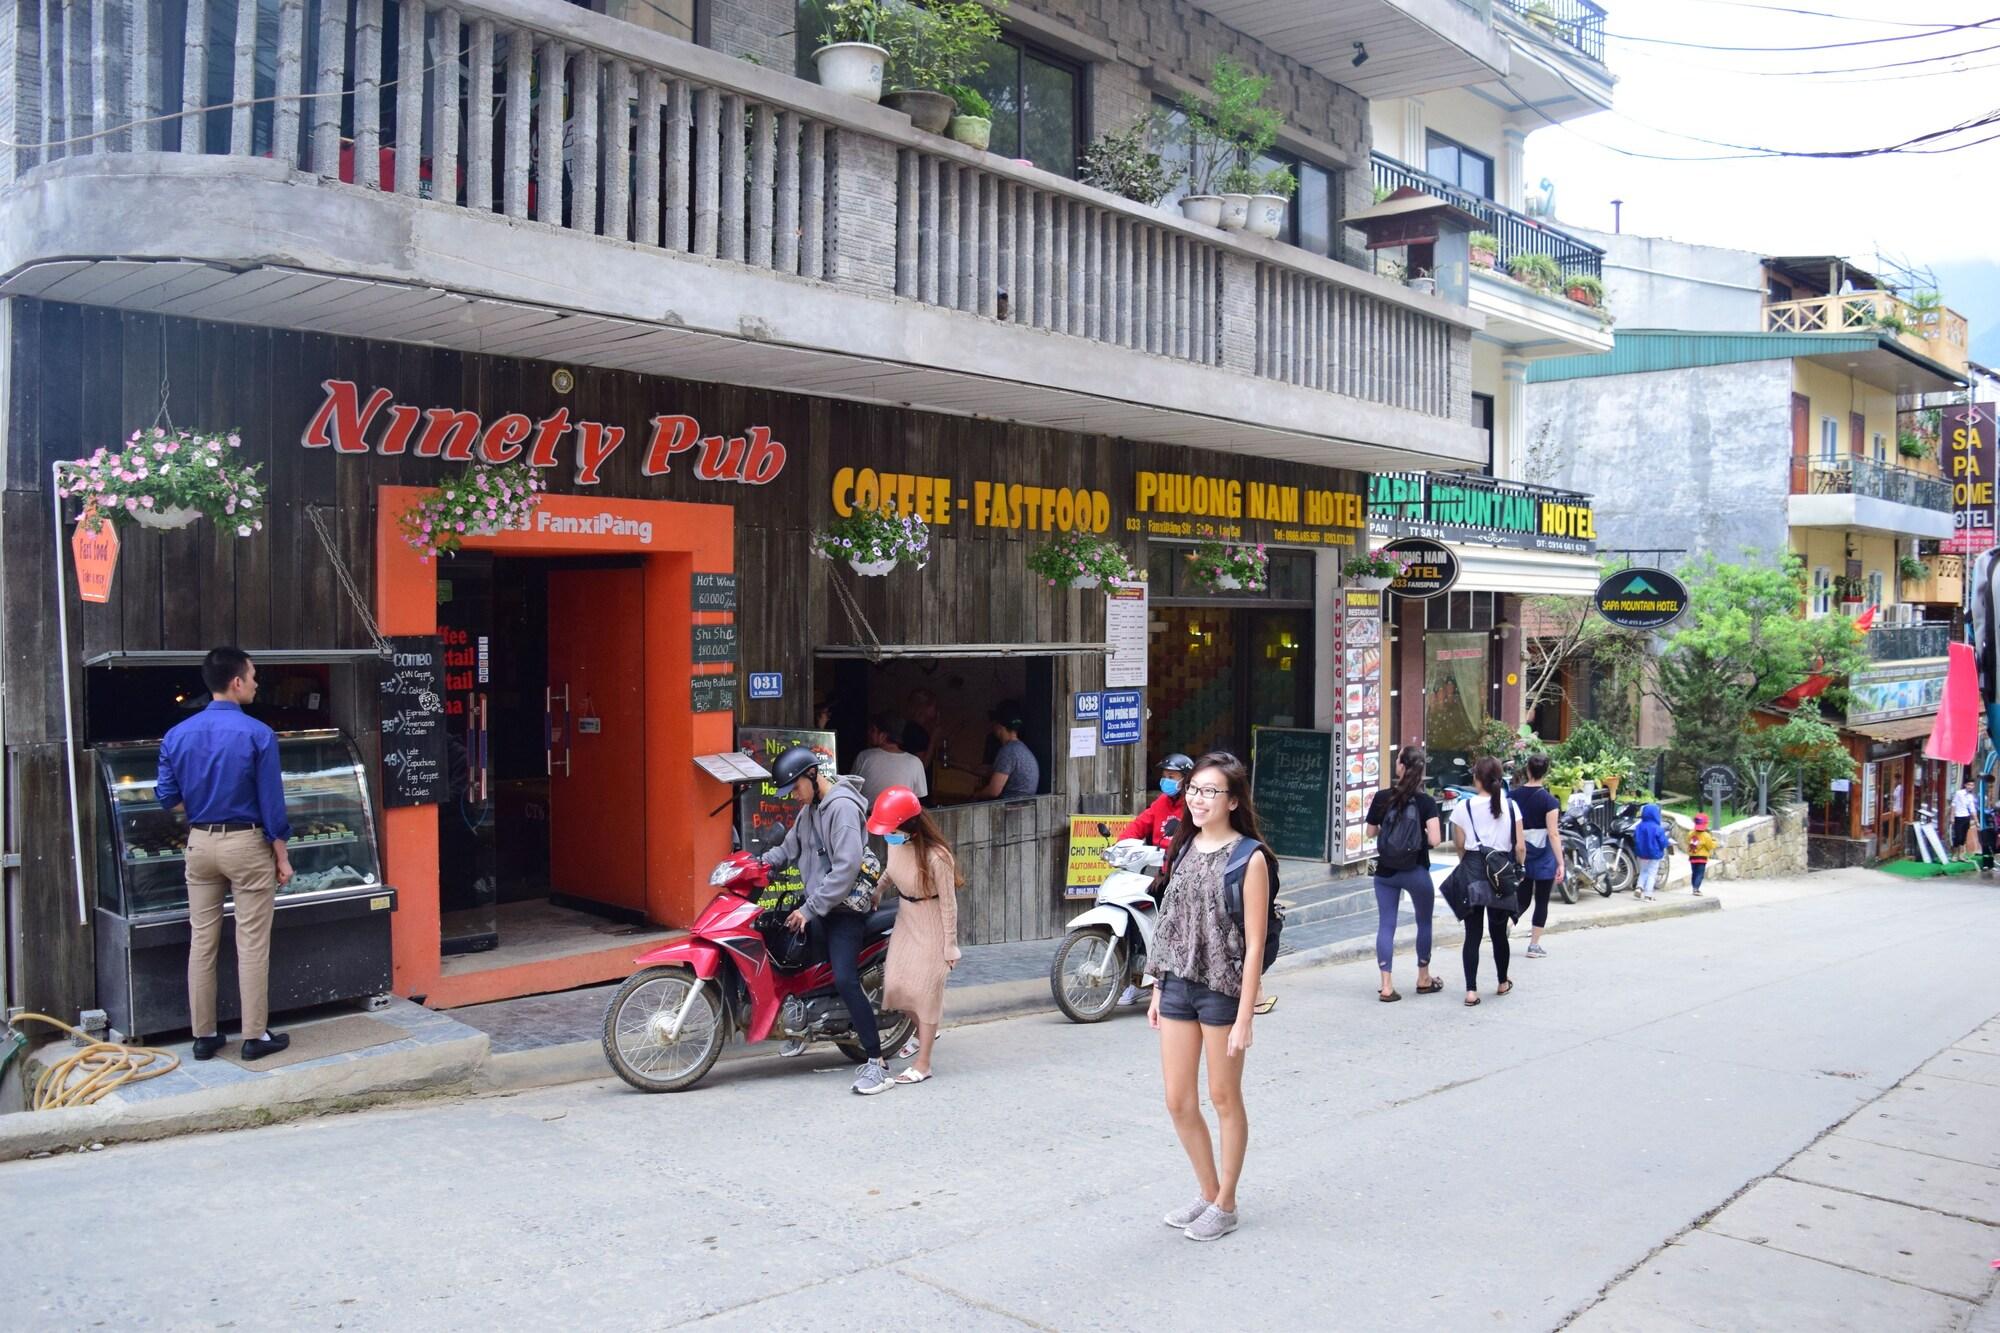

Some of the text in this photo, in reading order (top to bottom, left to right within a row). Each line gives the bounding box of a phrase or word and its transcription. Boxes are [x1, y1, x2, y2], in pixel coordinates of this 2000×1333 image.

[301, 379, 787, 485] Ninety Pub
[1952, 428, 1982, 450] SA
[1953, 455, 1981, 477] PA
[832, 467, 950, 525] COFFEE
[974, 481, 1110, 534] FASTFOOD
[1136, 471, 1365, 528] PHUONG NAM HOTEL
[1952, 483, 1993, 505] OME
[1431, 483, 1536, 532] MOUNTAIN
[1542, 501, 1597, 539] HOTEL
[1126, 518, 1140, 531] 033
[1953, 510, 1993, 528] OTEL
[537, 511, 653, 543] FanxiPăng
[1369, 522, 1445, 539] PAN TT SA PA
[1424, 551, 1448, 564] NAM
[1401, 566, 1442, 578] OTEL
[696, 575, 713, 586] Hot
[1391, 579, 1407, 588] 033
[1620, 600, 1655, 611] MOUNTAIN
[1656, 601, 1678, 611] HOTEL
[696, 627, 734, 640] Shi Sha
[753, 676, 778, 689] 031
[1079, 696, 1098, 711] 033
[1071, 847, 1085, 856] CHO
[1070, 861, 1106, 869] AUTOMATIC
